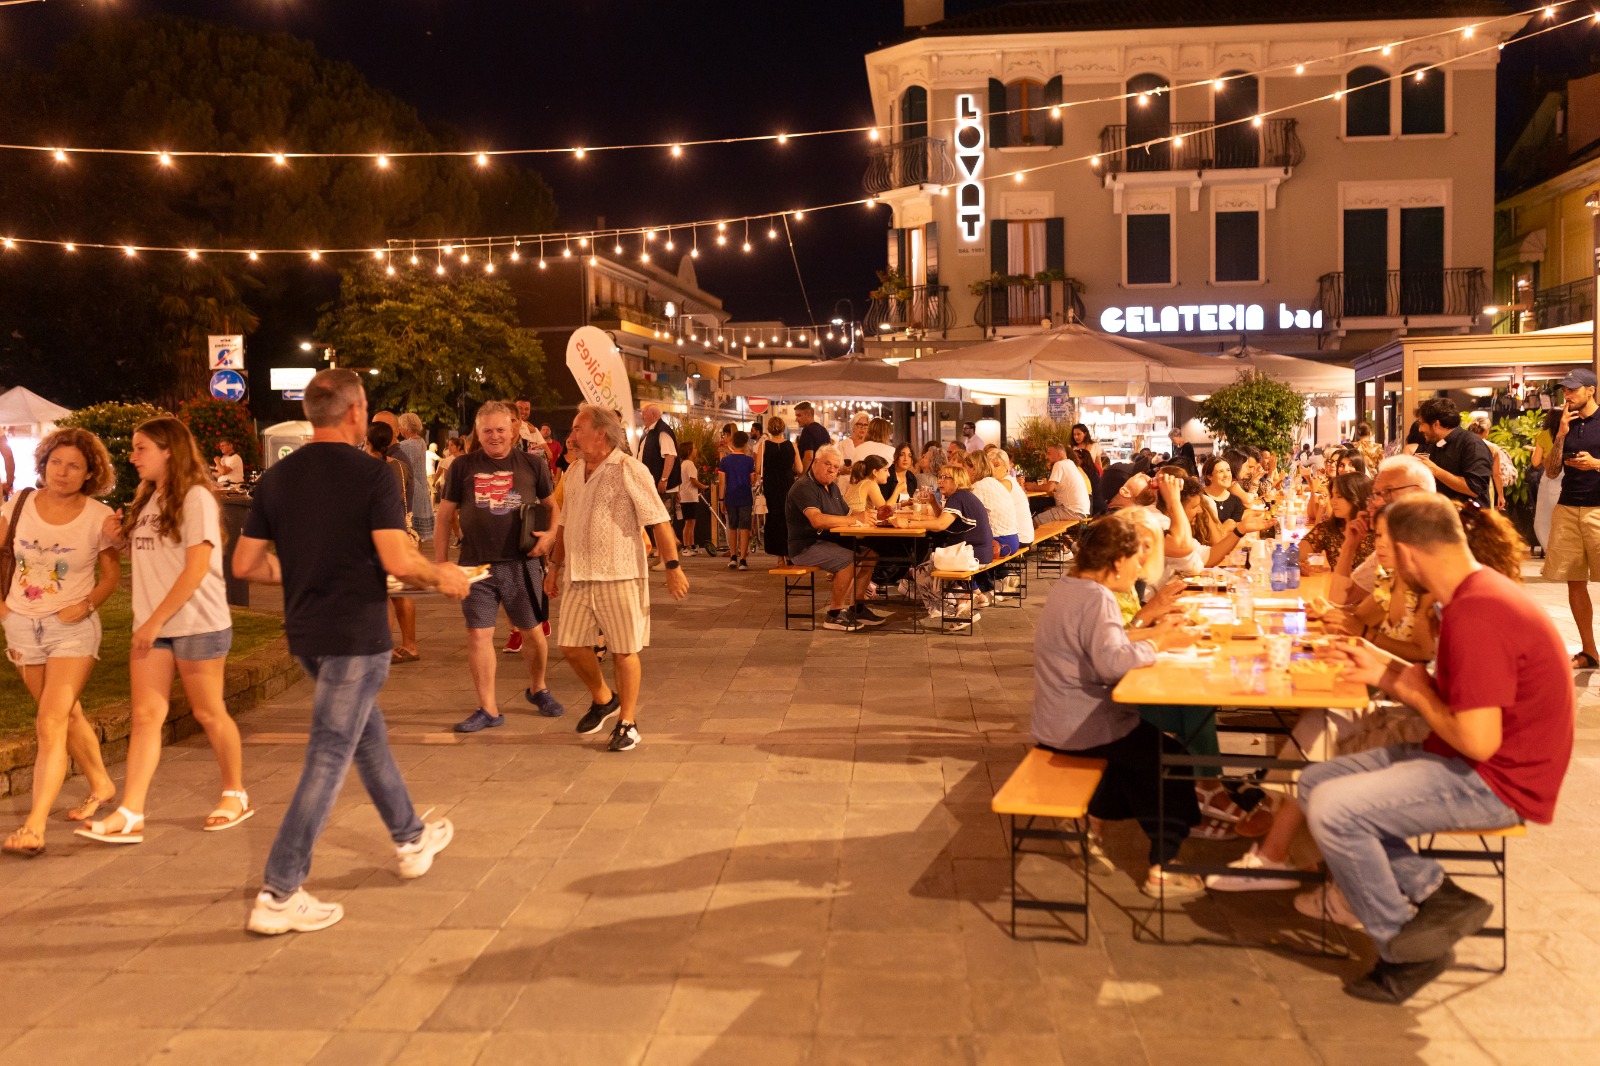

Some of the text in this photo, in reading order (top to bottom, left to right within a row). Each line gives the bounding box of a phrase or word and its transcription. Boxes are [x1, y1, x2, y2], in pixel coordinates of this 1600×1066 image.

[957, 96, 983, 238] LOVAT
[1100, 303, 1323, 333] GELATERIA bar
